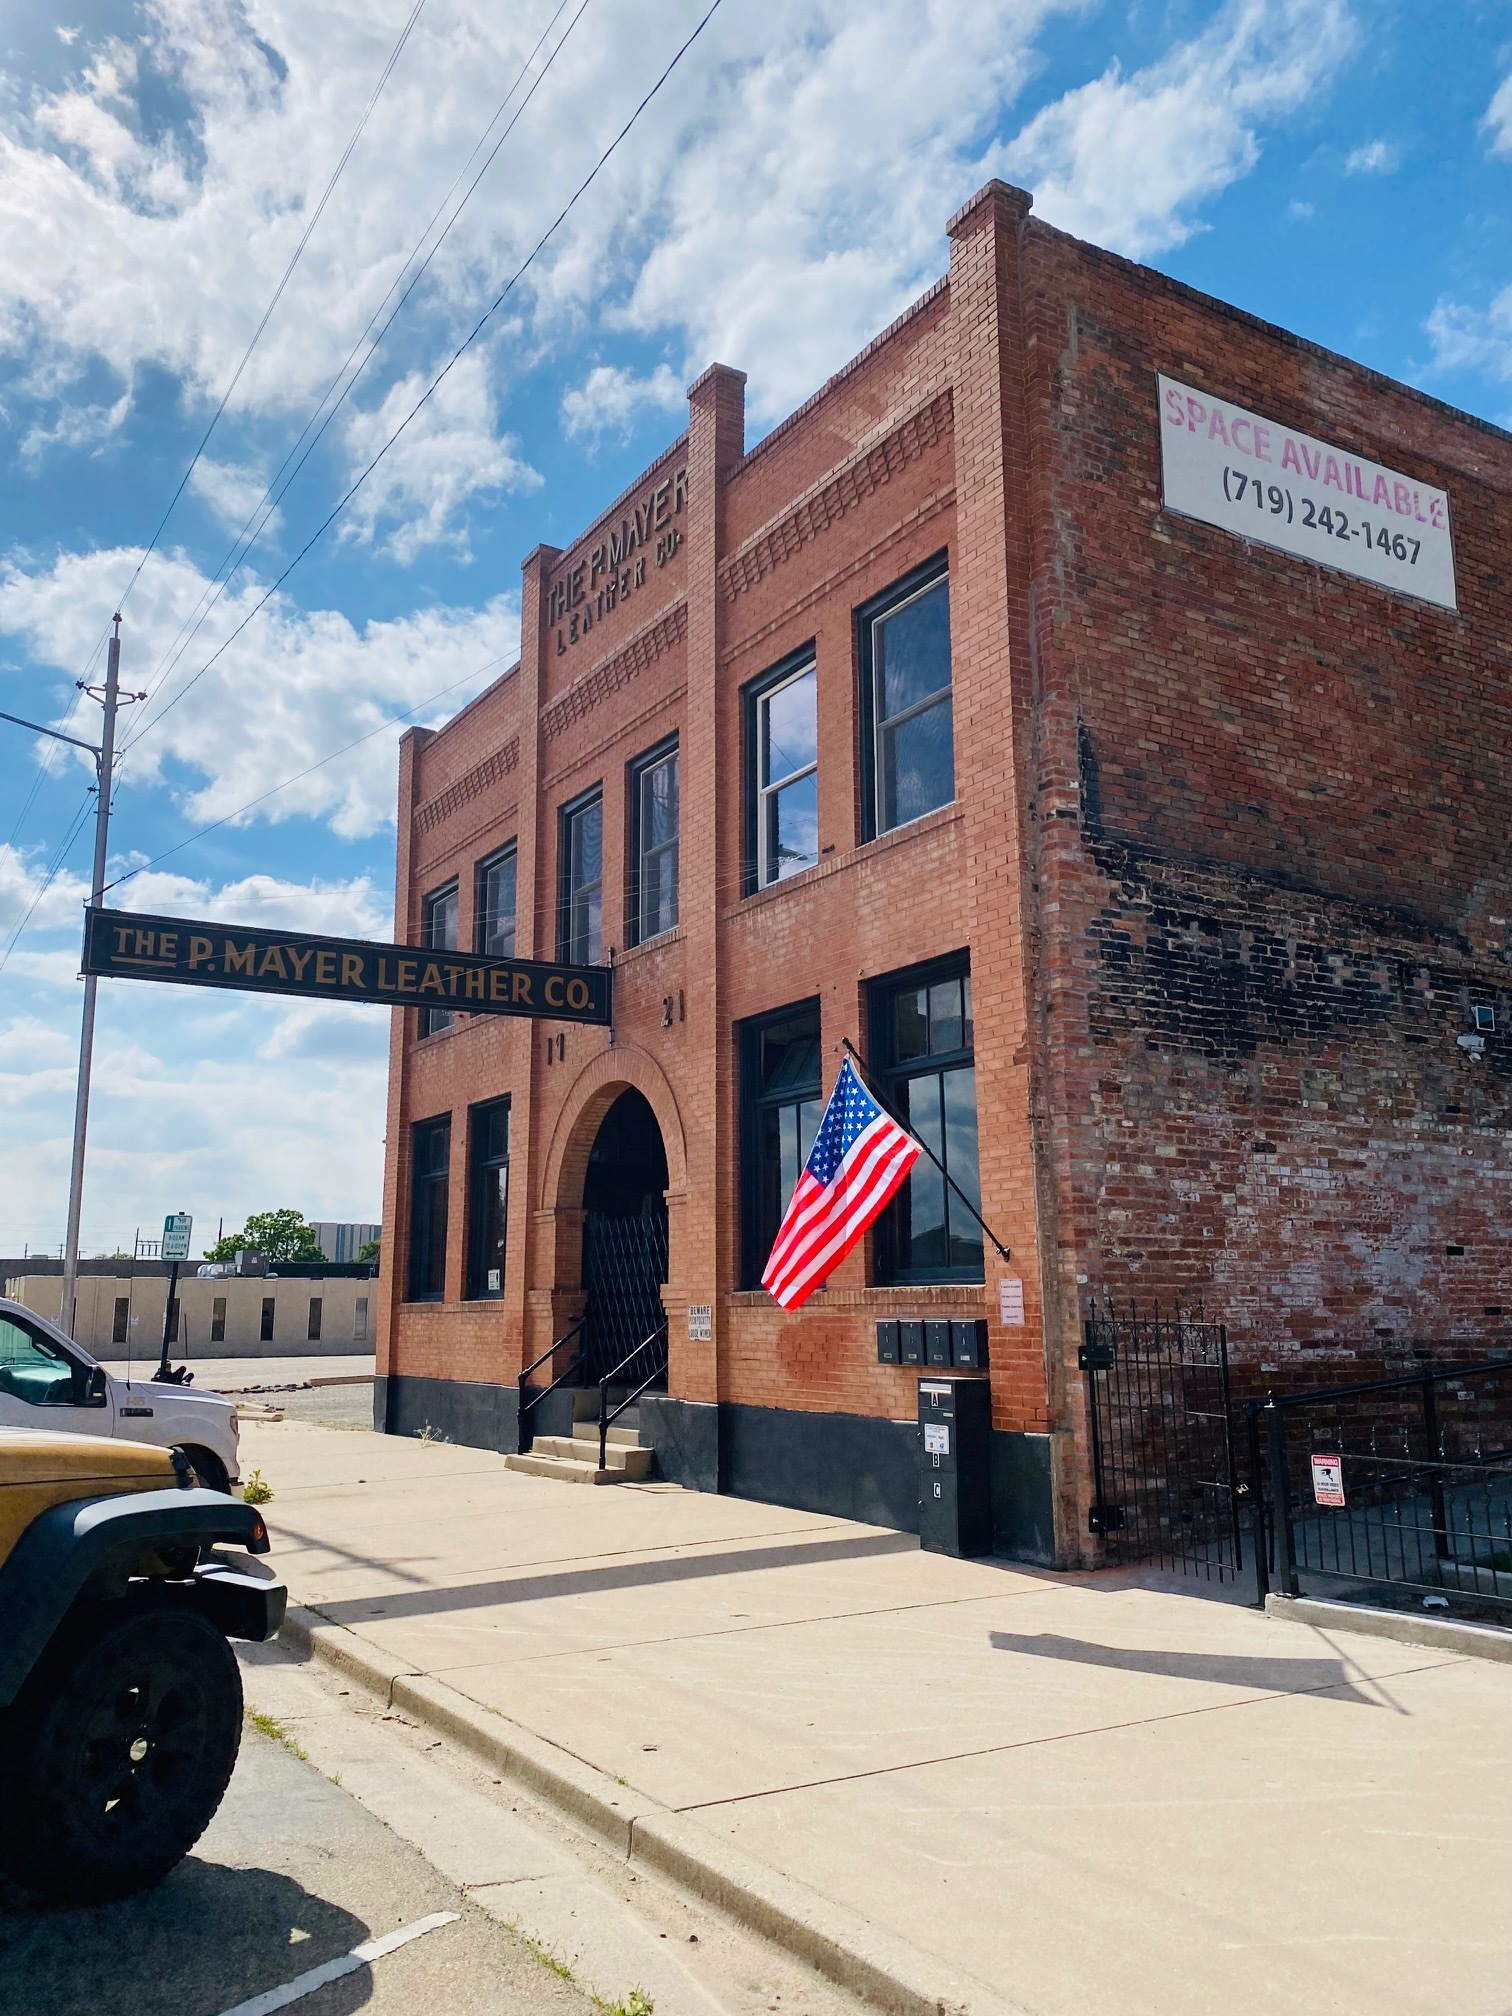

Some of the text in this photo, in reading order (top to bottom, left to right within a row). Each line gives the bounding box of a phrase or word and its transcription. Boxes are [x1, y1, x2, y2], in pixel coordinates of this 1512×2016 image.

[1165, 388, 1447, 531] SPACE AVAILABLE
[546, 559, 587, 628] THE
[607, 463, 689, 574] MAYER
[113, 926, 595, 1011] THE P. MAYER LEATHER CO.
[690, 1305, 710, 1315] BEWARE
[1313, 1457, 1339, 1466] WARNING
